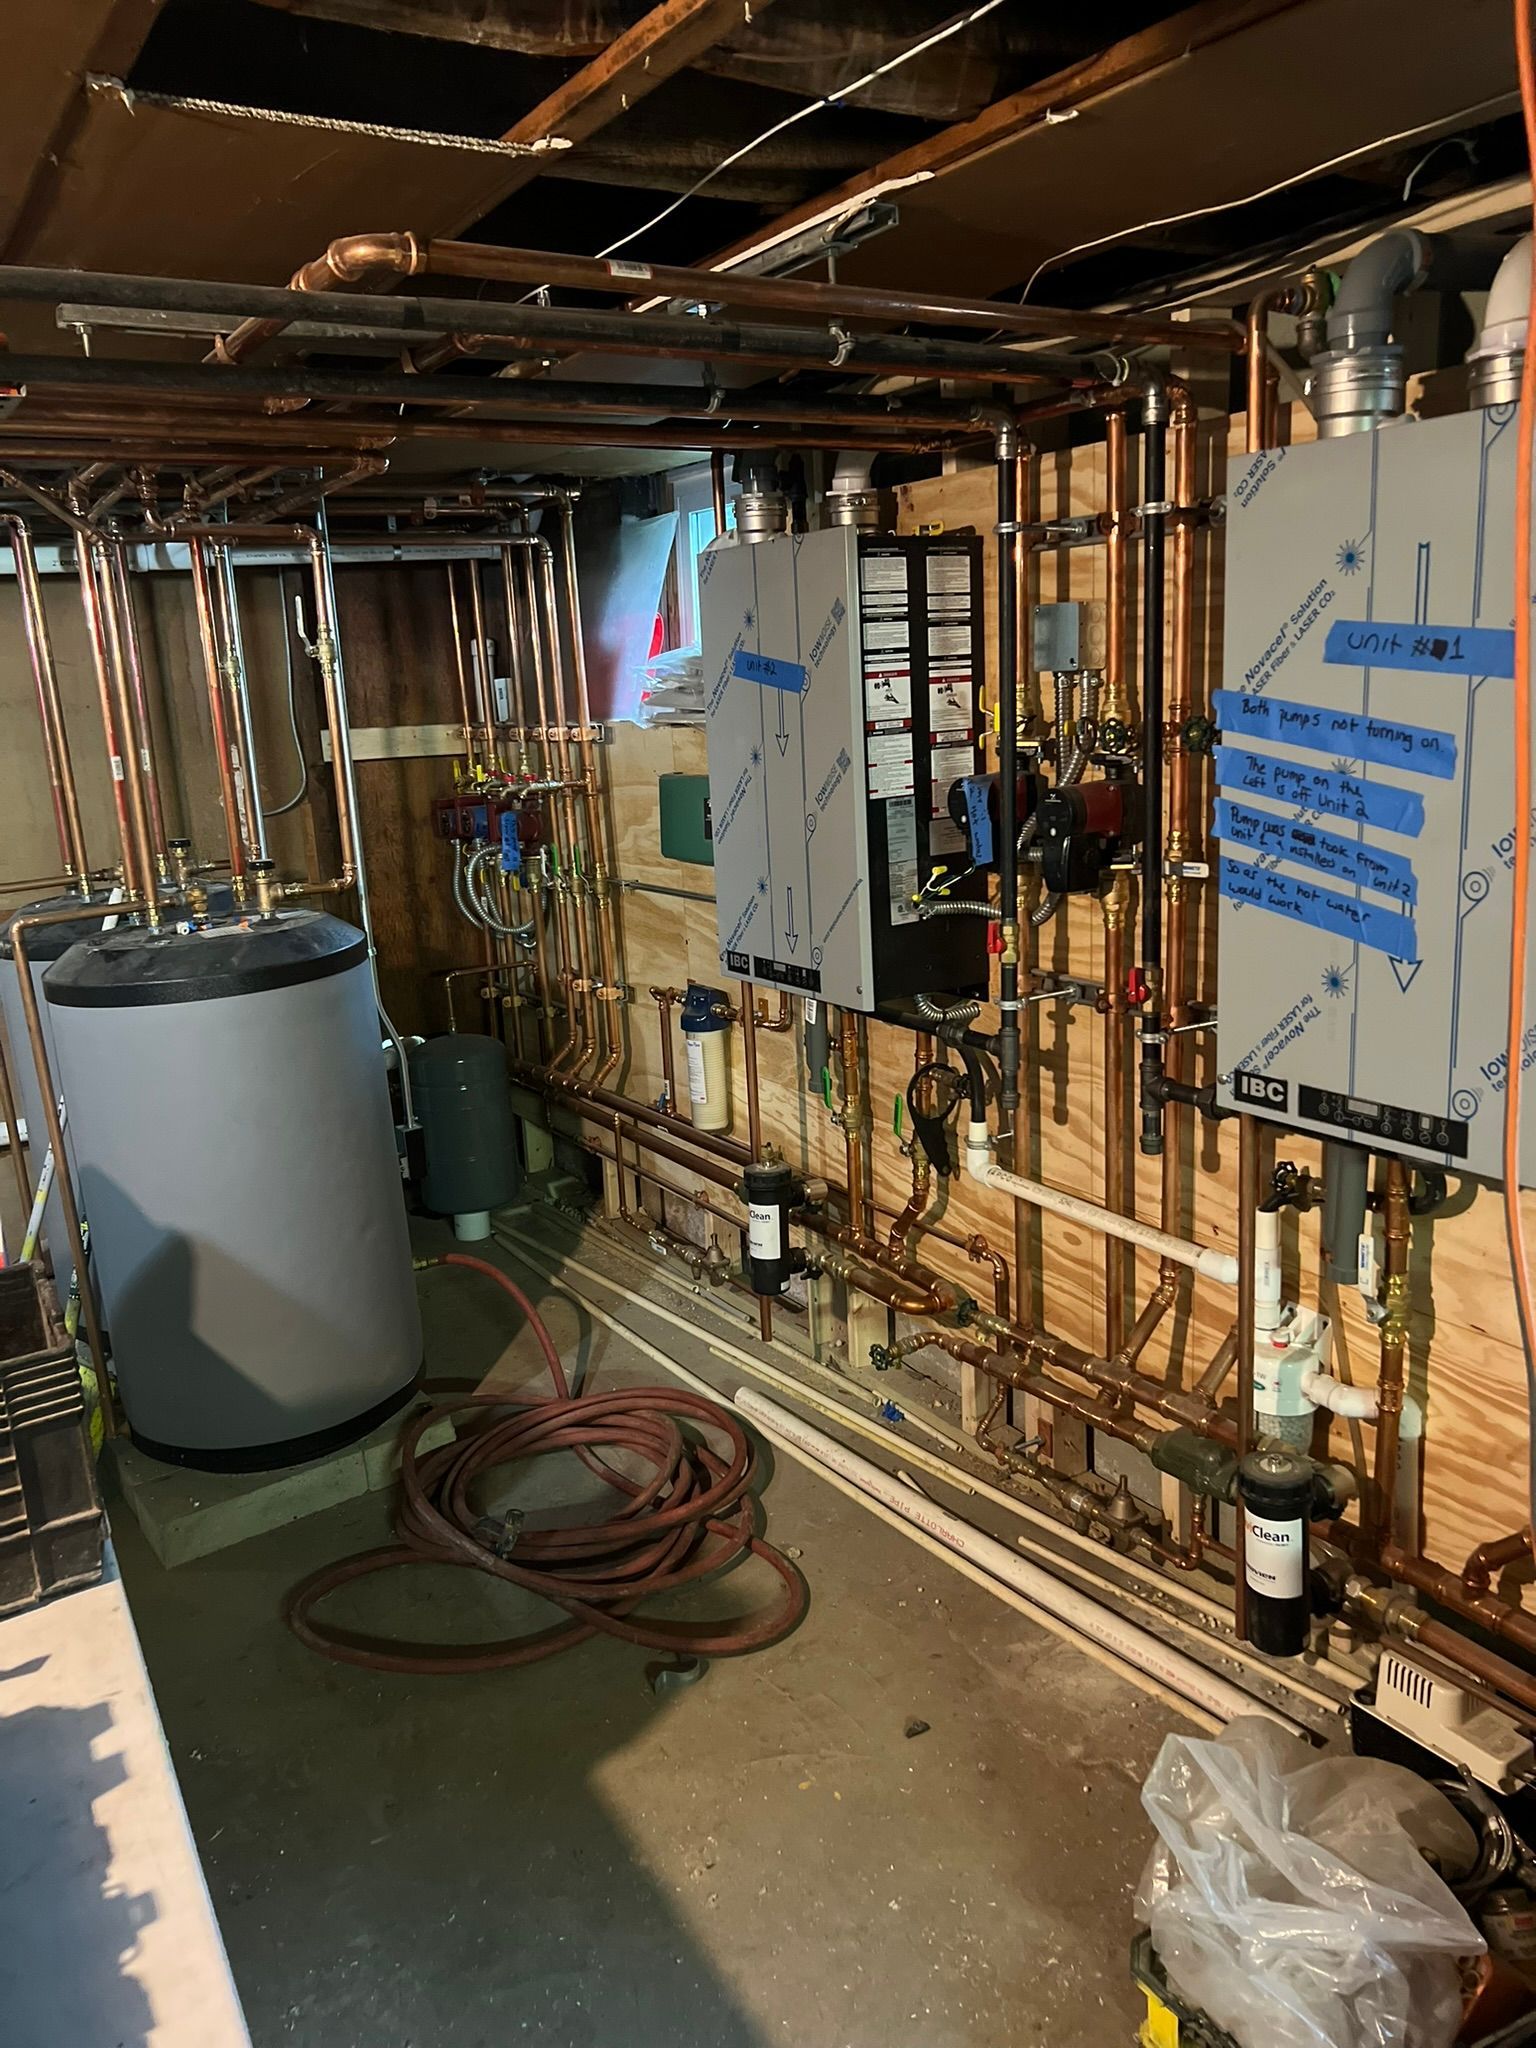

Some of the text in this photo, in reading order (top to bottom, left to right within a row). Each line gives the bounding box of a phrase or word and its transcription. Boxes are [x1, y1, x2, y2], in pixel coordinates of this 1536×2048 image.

[1290, 578, 1328, 625] Solution
[1294, 608, 1321, 641] LASER
[1242, 697, 1270, 717] Both
[1279, 708, 1320, 730] pumps
[1331, 718, 1360, 732] not
[1366, 719, 1414, 753] turning
[1245, 755, 1364, 798] The pump on the
[1276, 783, 1286, 796] is
[1292, 785, 1312, 803] off
[1355, 801, 1369, 821] 2
[1230, 805, 1260, 834] Pump
[1263, 821, 1286, 838] was
[1319, 837, 1350, 859] took
[1259, 833, 1268, 847] 1
[1342, 864, 1356, 879] on
[1402, 883, 1412, 898] 2
[1226, 859, 1240, 875] So
[1243, 868, 1257, 881] as
[1266, 874, 1287, 896] the
[1296, 879, 1321, 902] hot
[1325, 898, 1372, 924] water
[1227, 882, 1304, 916] would work
[729, 953, 749, 969] IBC
[1278, 1005, 1302, 1032] LASER
[1300, 994, 1313, 1008] for
[1303, 1006, 1321, 1023] The
[1261, 1027, 1280, 1048] Fiber
[1241, 1075, 1285, 1102] IBC
[889, 1495, 965, 1548] CHARLOTTE PIPE
